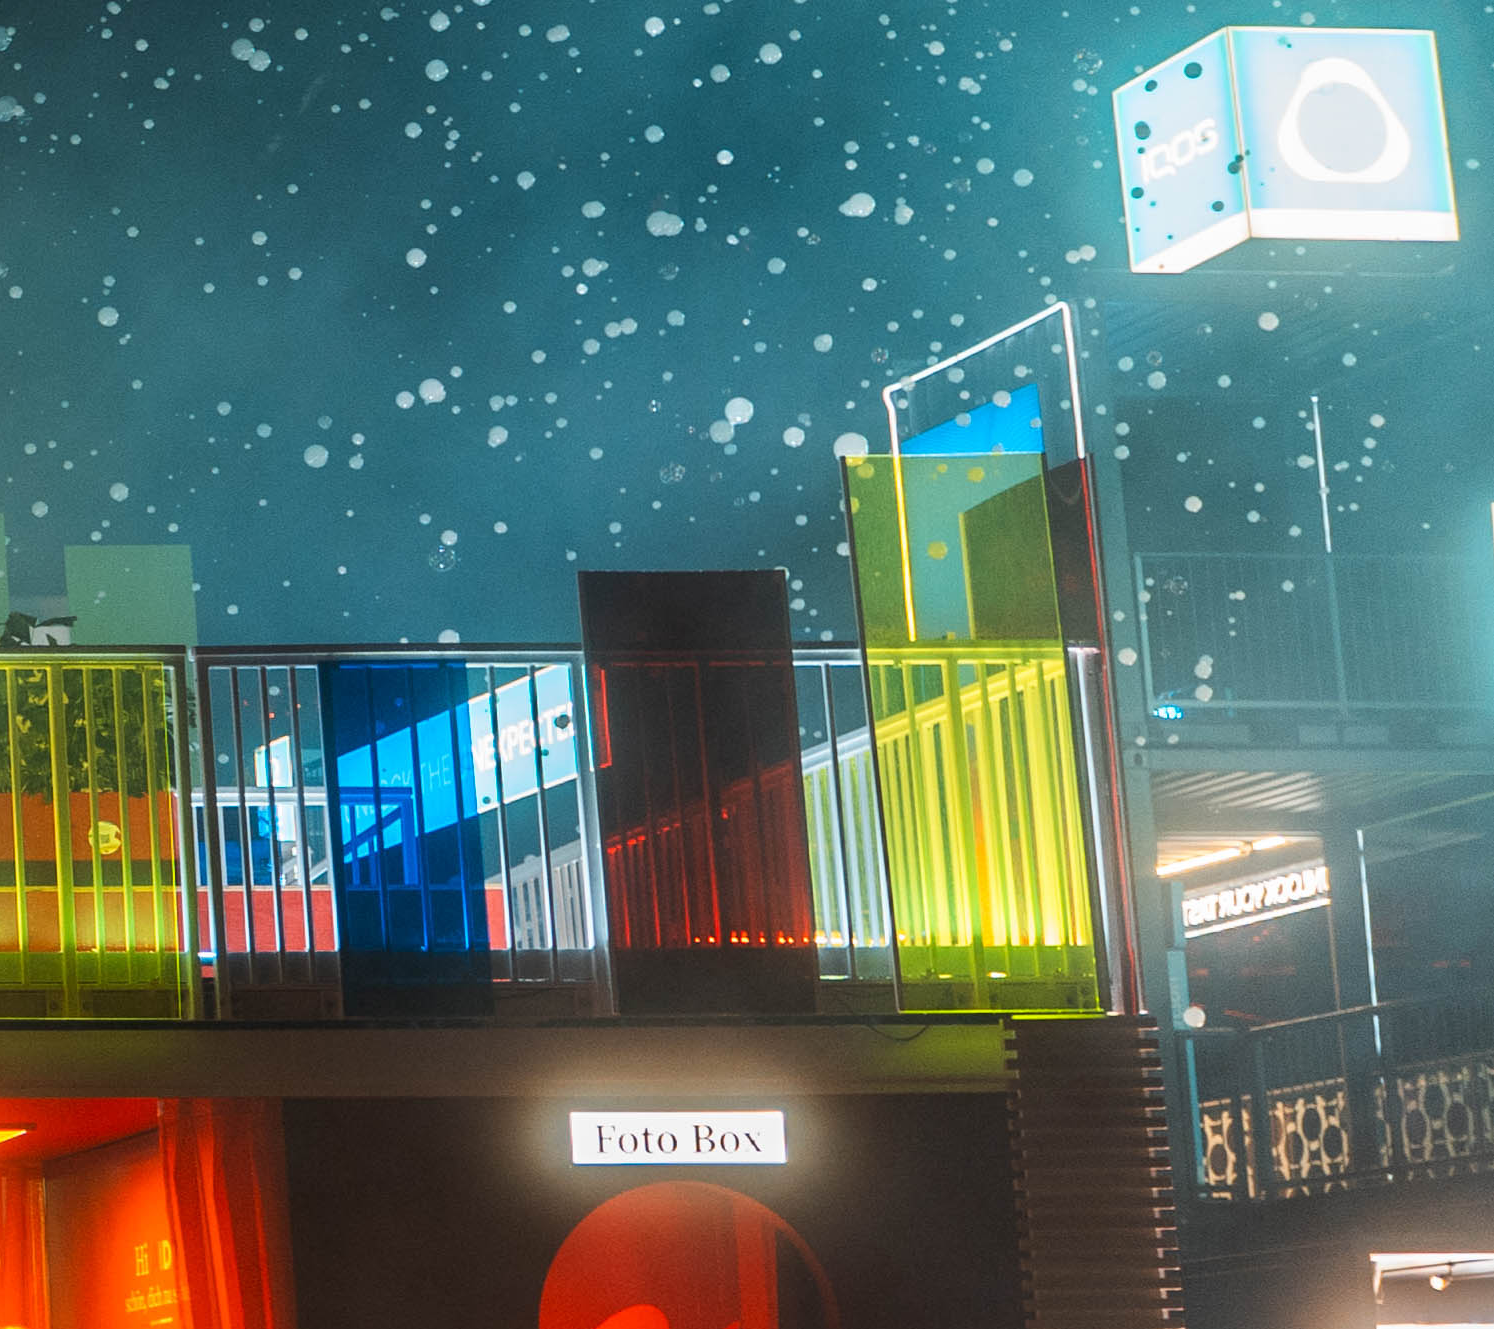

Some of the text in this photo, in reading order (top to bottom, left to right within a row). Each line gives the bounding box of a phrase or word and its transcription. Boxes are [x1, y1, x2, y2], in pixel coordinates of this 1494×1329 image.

[1141, 118, 1220, 184] IQOS
[597, 1124, 763, 1154] Foto Box
